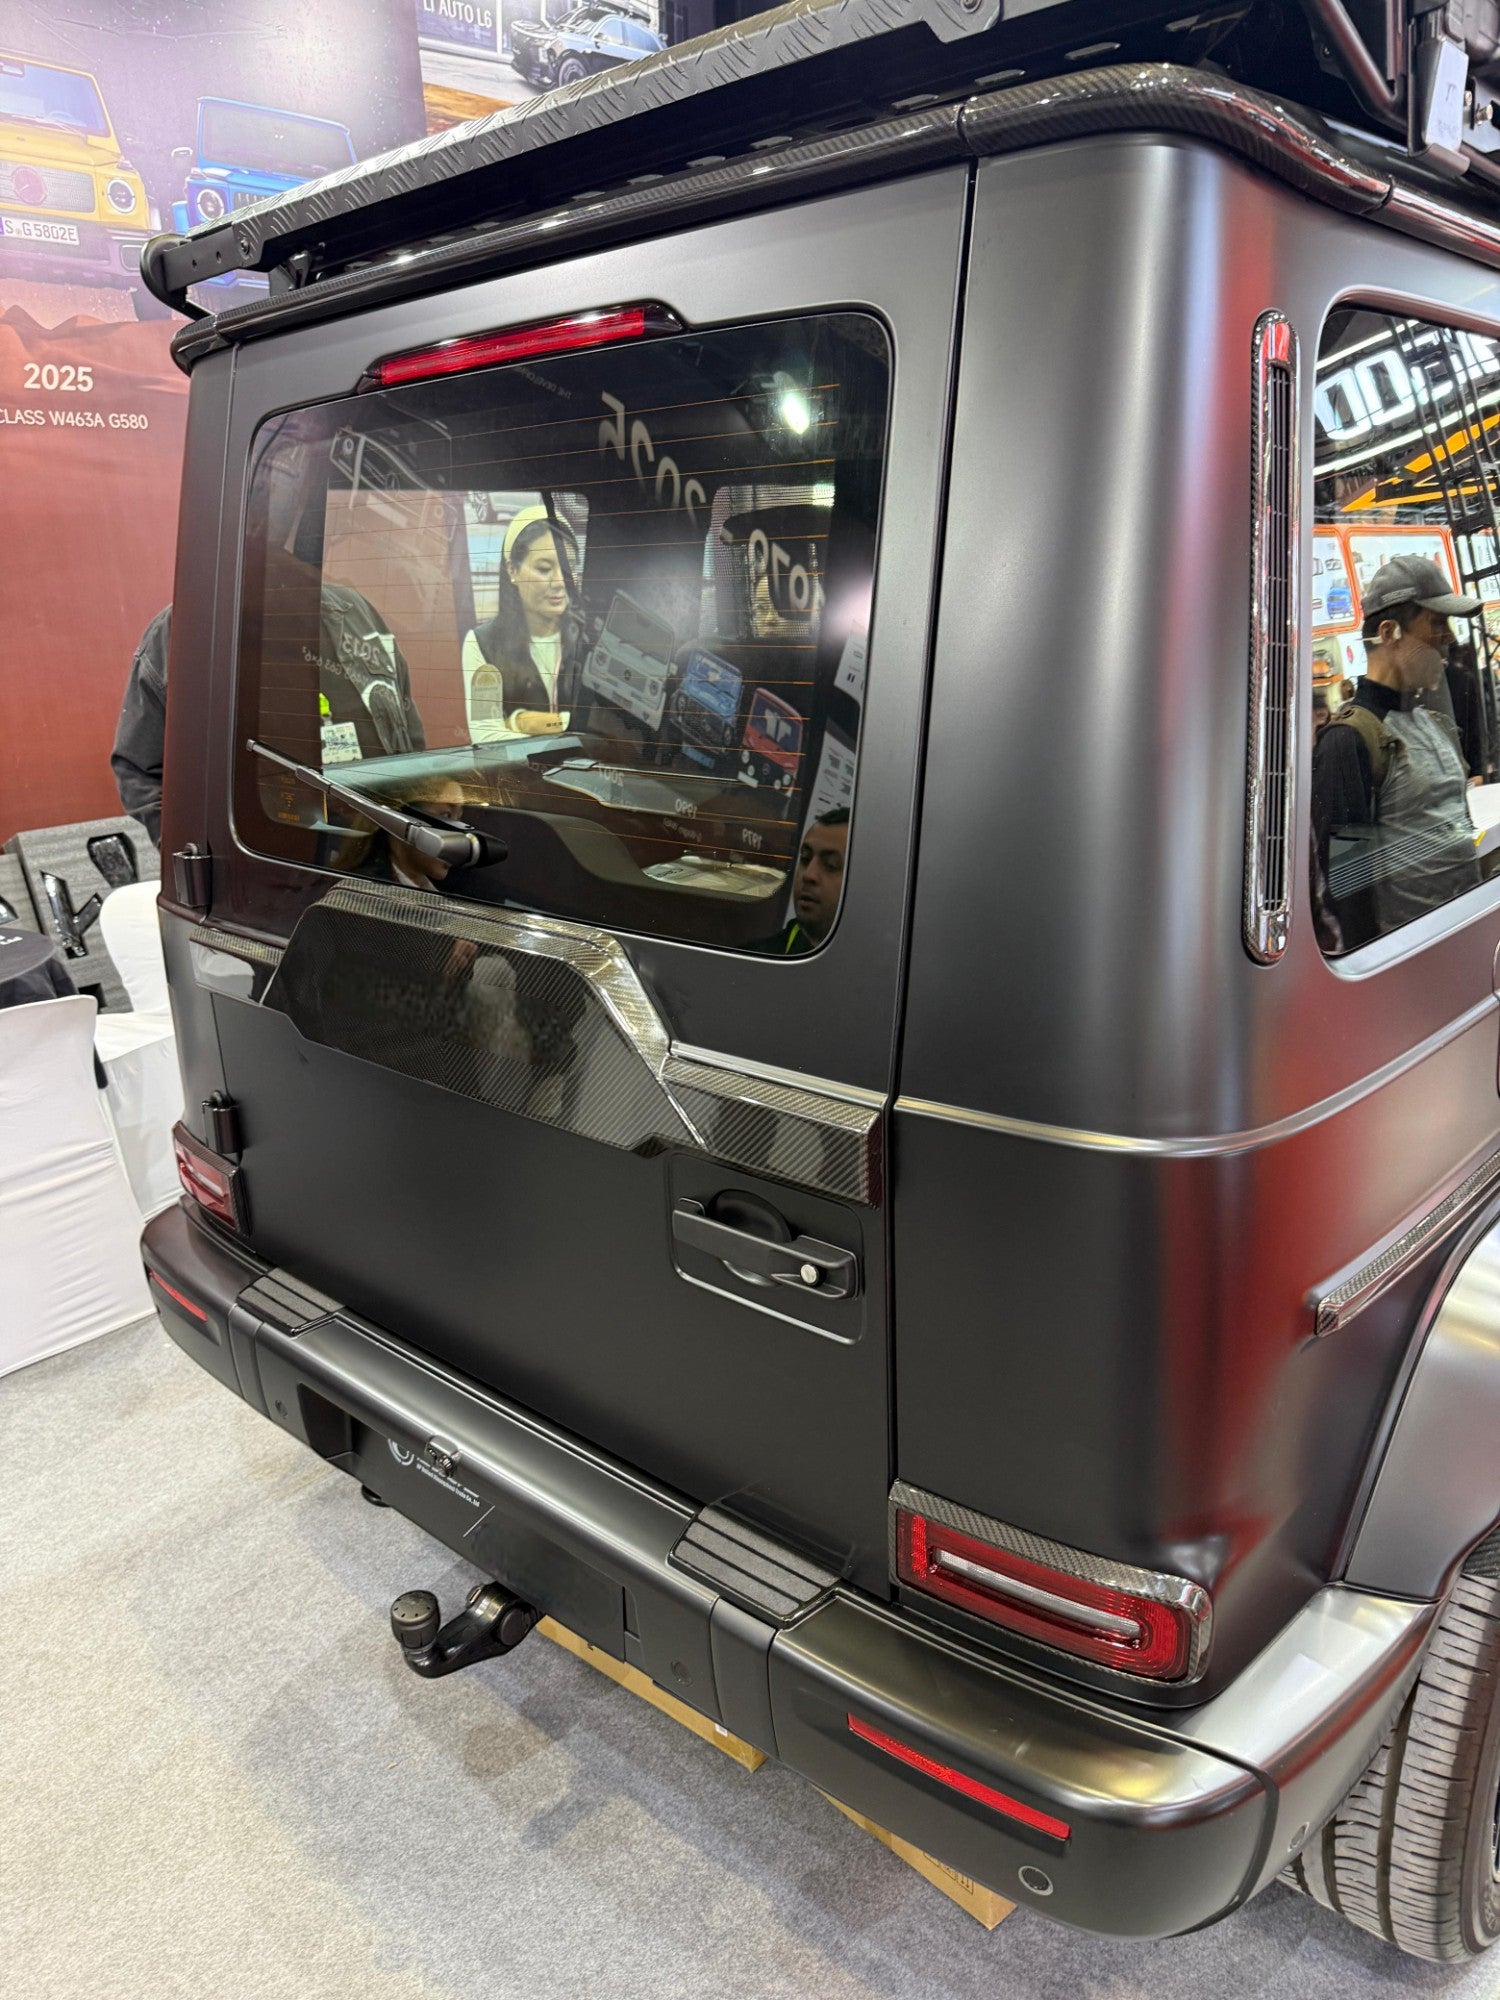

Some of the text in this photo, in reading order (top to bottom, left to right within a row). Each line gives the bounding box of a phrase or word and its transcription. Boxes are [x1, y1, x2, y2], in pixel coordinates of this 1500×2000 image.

[438, 0, 475, 23] AUTO
[476, 7, 492, 29] L6
[23, 362, 94, 392] 2025
[48, 409, 106, 428] W463A
[108, 412, 149, 430] G580
